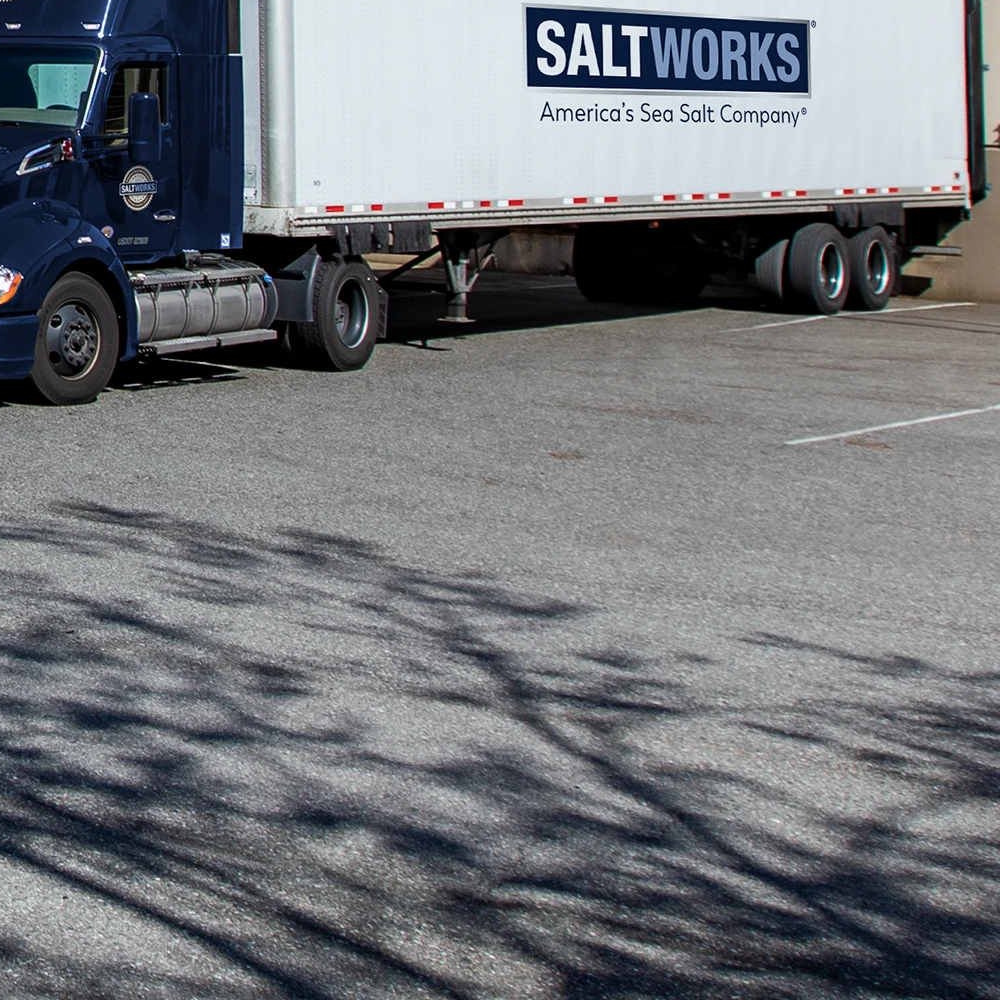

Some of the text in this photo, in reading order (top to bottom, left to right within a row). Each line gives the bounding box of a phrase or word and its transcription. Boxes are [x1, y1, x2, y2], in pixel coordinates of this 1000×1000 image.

[536, 19, 801, 84] SALTWORKS
[540, 101, 635, 123] America's
[640, 103, 675, 123] Sea
[680, 104, 716, 124] Salt
[121, 182, 156, 194] SALTWORKS
